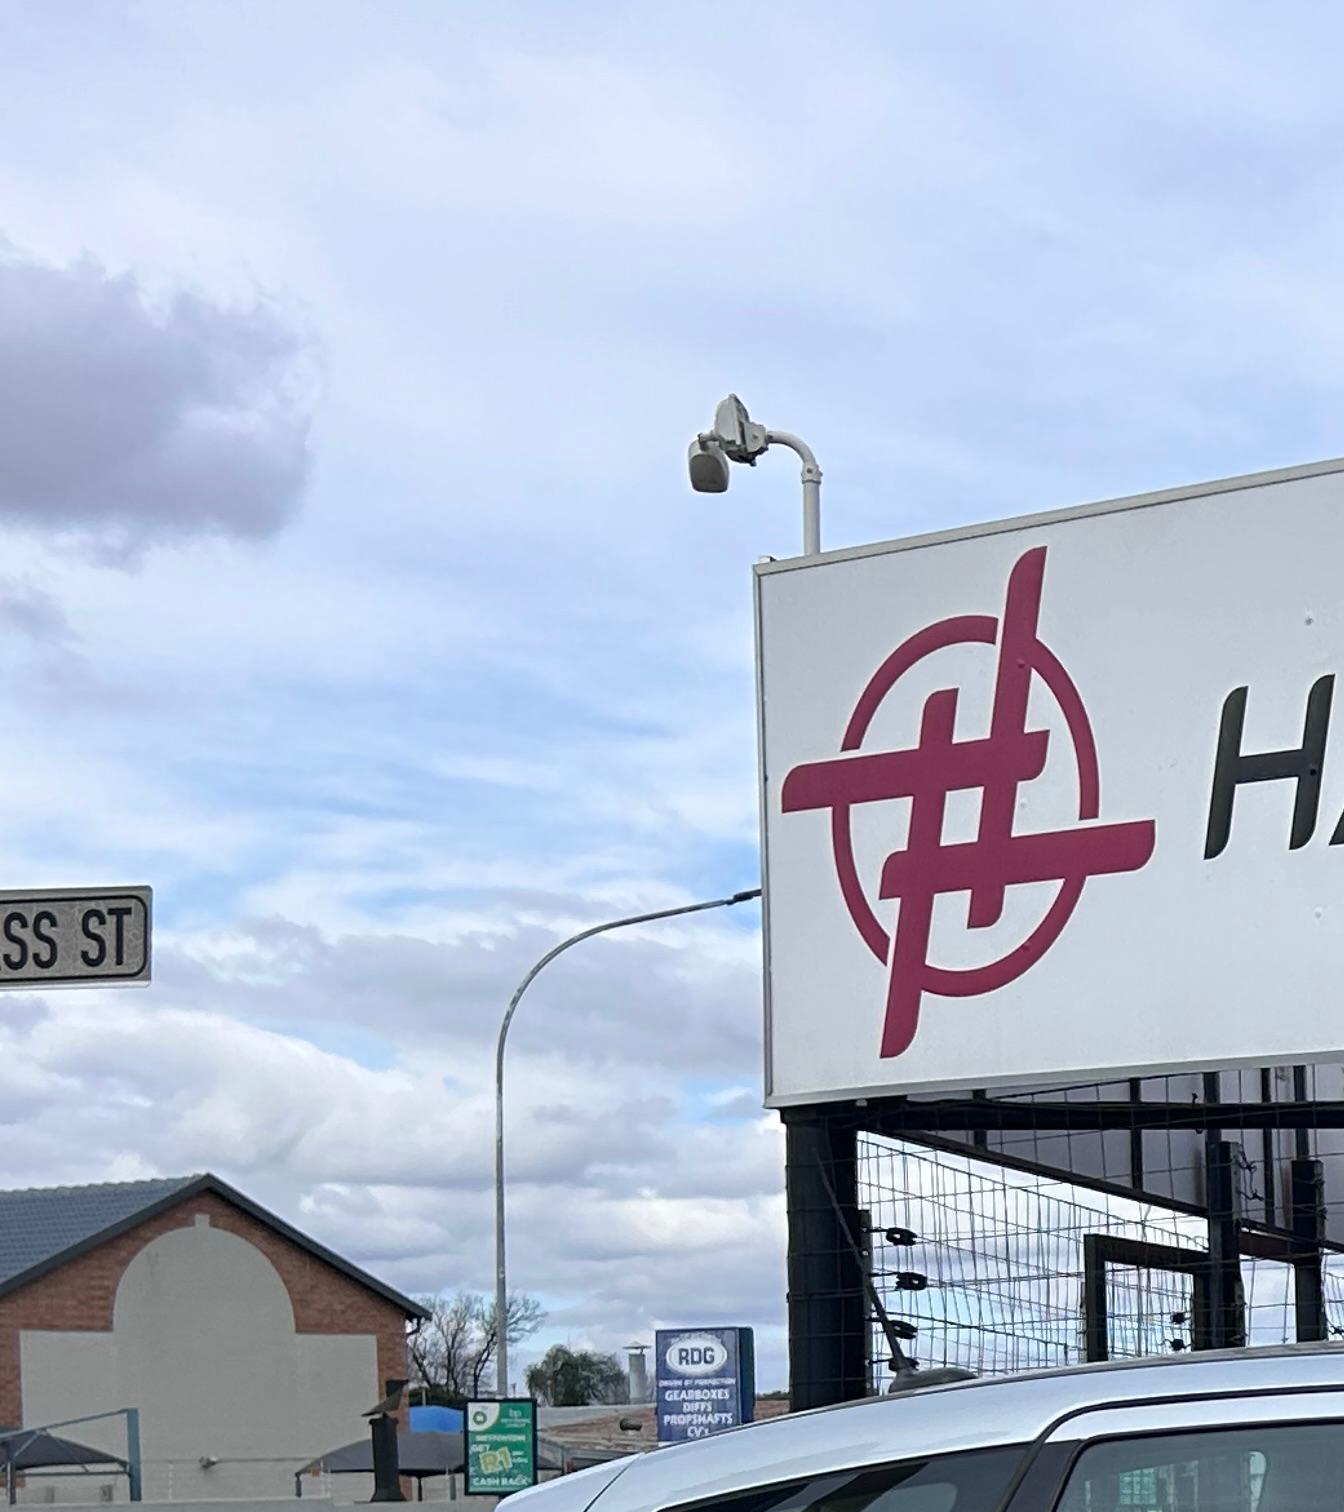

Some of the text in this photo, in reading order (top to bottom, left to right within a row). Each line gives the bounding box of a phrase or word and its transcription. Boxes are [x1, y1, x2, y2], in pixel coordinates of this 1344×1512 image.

[0, 907, 132, 971] SS ST
[678, 1347, 715, 1366] RDG
[665, 1388, 730, 1401] GEARBOXES
[682, 1401, 712, 1413] DIFFS
[663, 1413, 733, 1426] PROPSHAFTS
